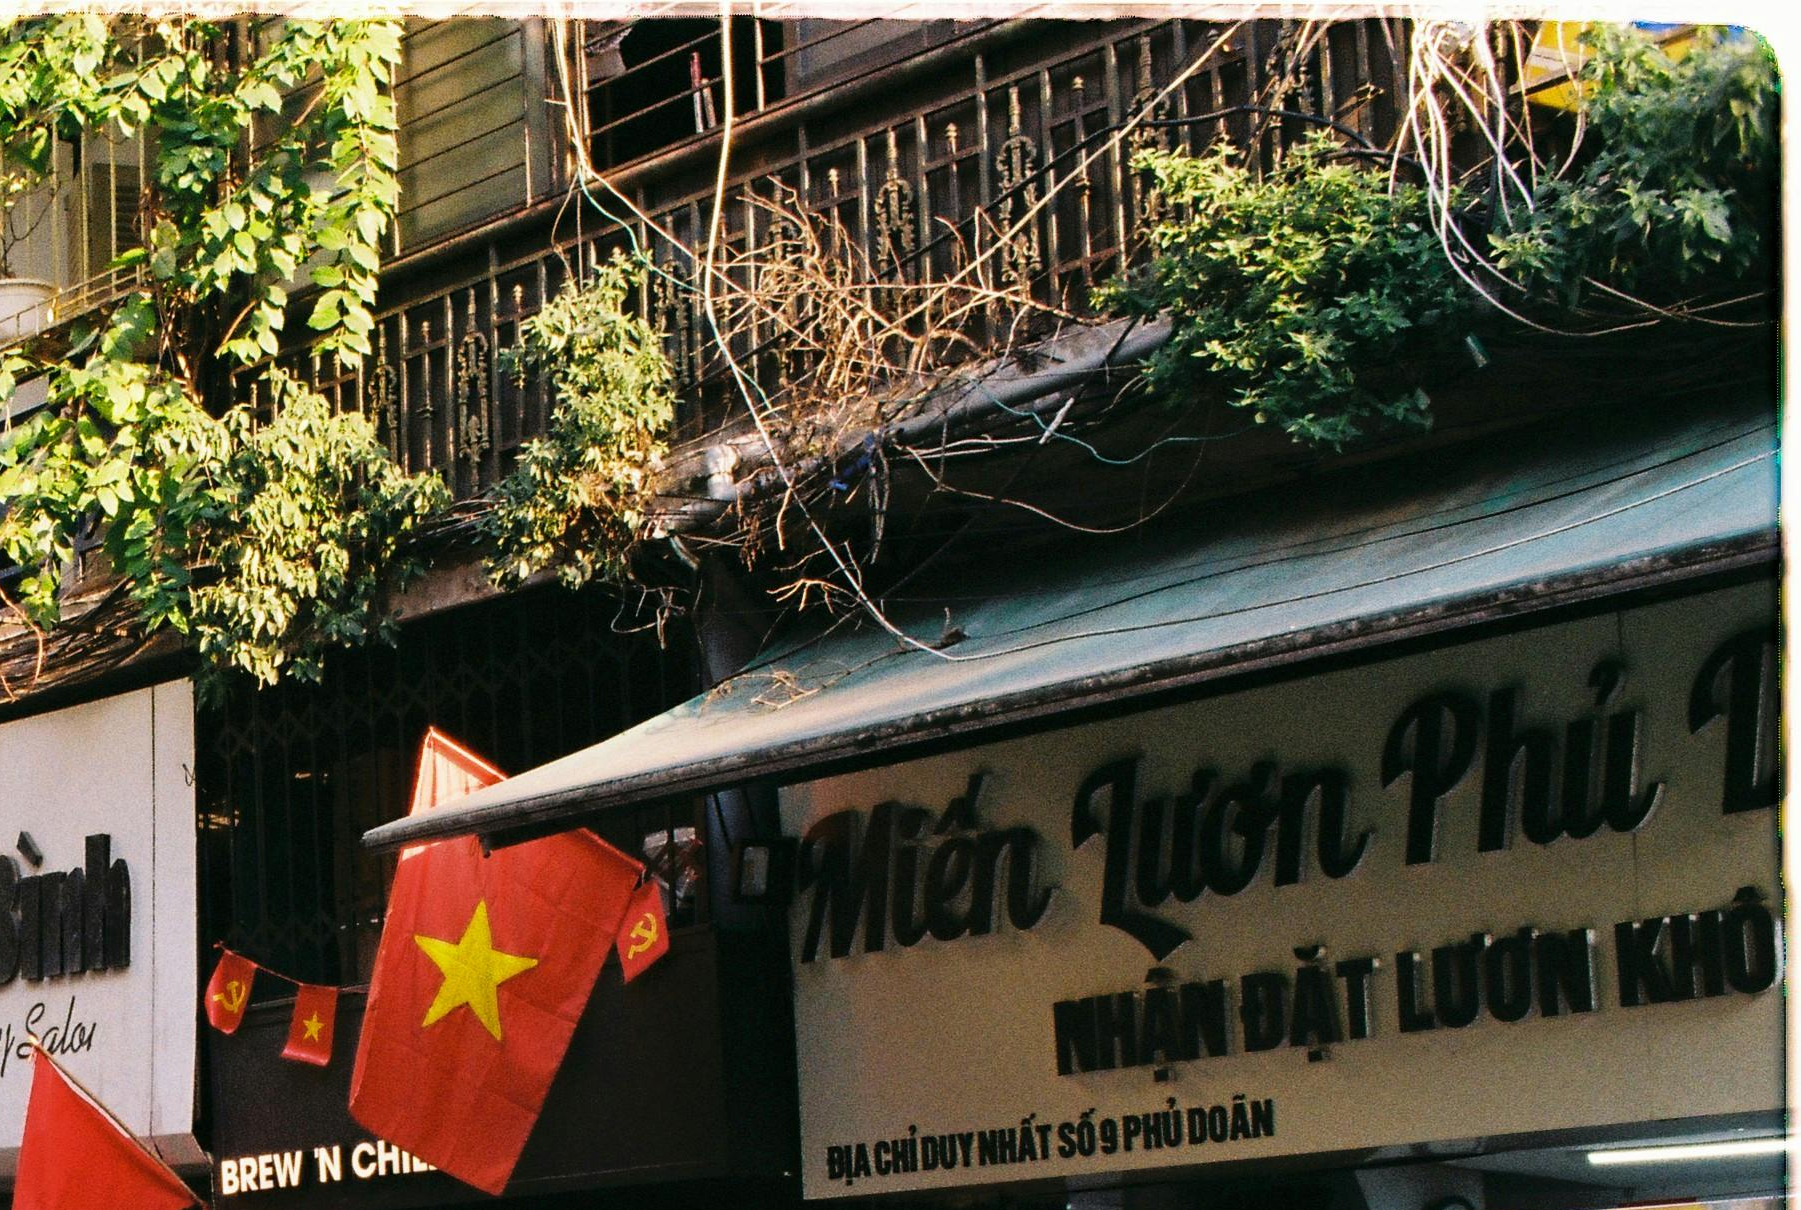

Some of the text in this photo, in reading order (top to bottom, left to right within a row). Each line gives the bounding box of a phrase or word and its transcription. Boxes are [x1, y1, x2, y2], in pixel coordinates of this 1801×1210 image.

[799, 770, 1061, 963] Miến
[1072, 752, 1377, 961] Lươn
[1382, 658, 1666, 865] Phủ
[1053, 966, 1228, 1082] NHẬN
[1240, 945, 1380, 1062] ĐẶT
[1398, 927, 1597, 1033] LƯƠN
[221, 1139, 439, 1195] BREW 'N CHIL
[827, 1094, 1275, 1186] ĐỊA CHỈ DUY NHẤT SỐ 9 PHỦ DOÃN
